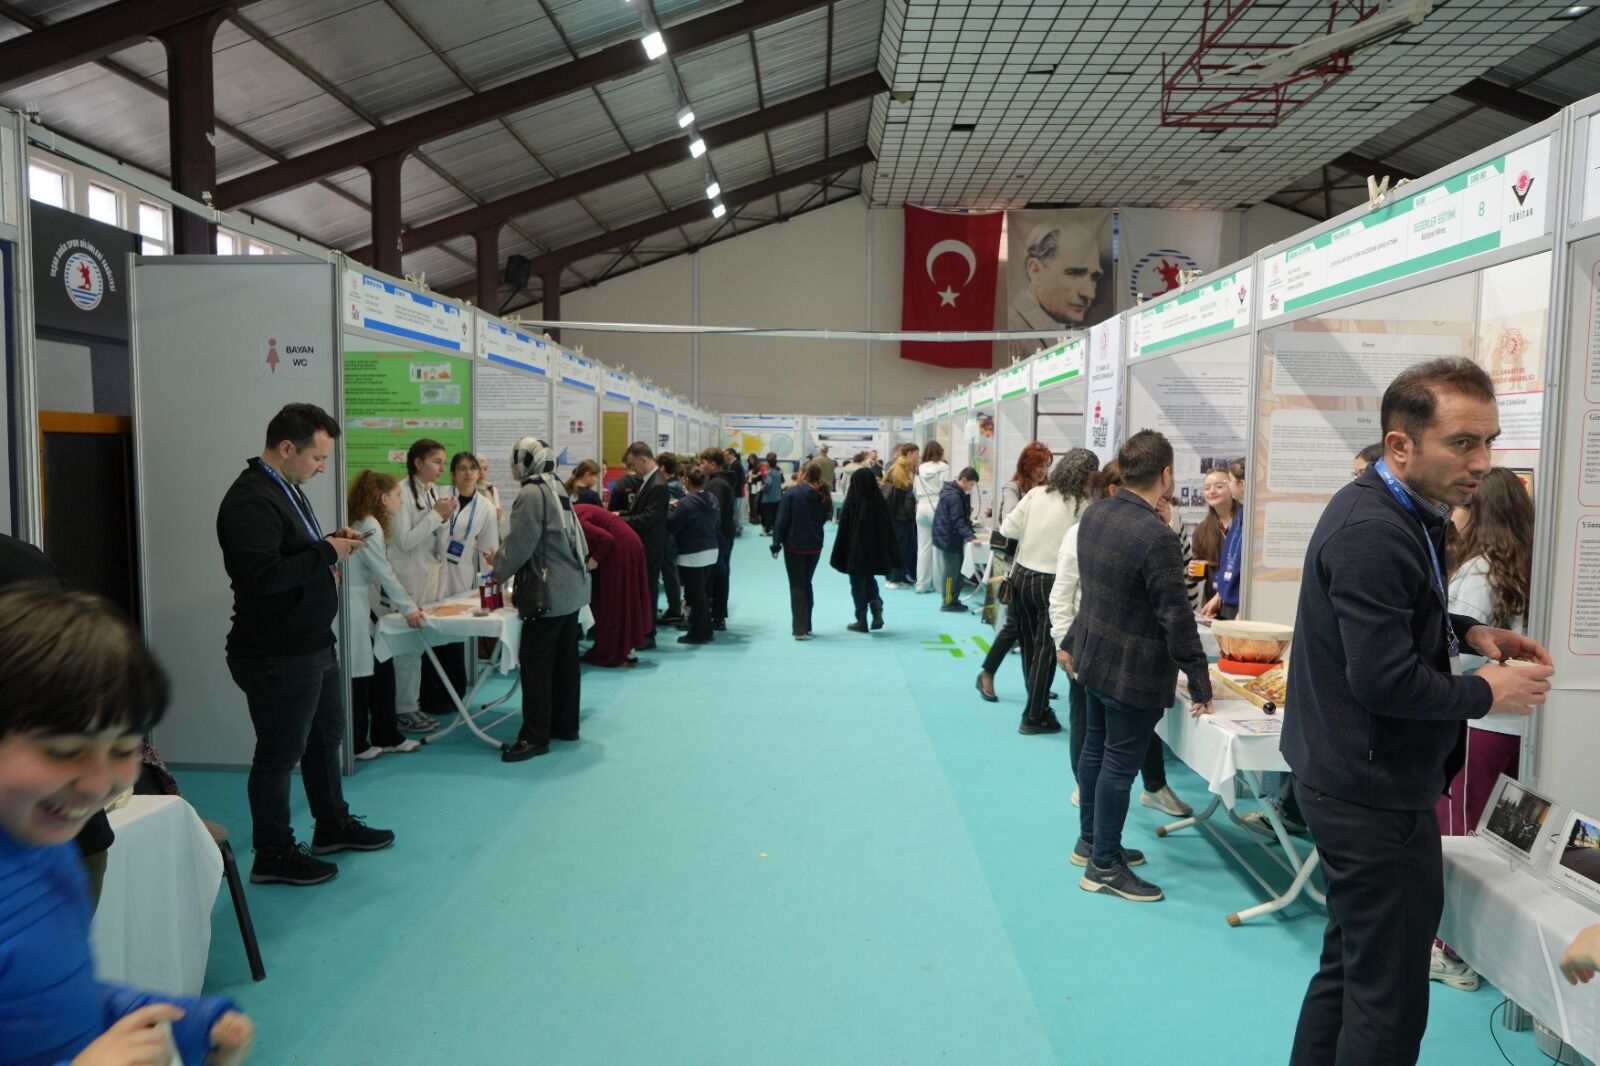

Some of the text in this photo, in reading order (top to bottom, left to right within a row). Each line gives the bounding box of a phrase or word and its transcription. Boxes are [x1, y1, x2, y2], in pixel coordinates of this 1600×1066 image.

[1478, 201, 1485, 217] 8
[1509, 208, 1534, 223] TÜBİTAK
[286, 346, 314, 354] BAYAN
[293, 359, 307, 367] WC
